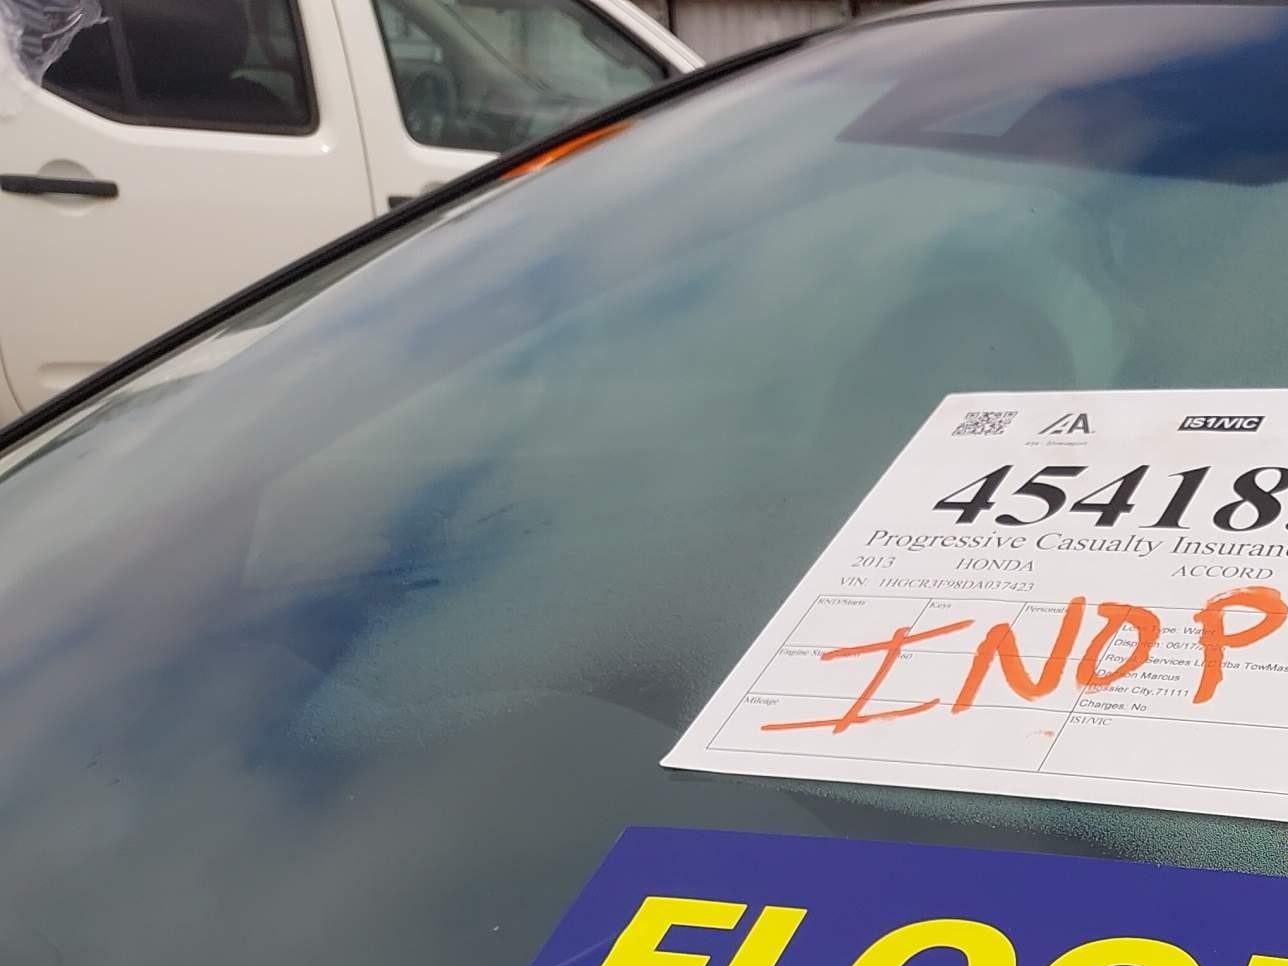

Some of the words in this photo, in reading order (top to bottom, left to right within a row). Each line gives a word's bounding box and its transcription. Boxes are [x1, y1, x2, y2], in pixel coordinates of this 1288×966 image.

[866, 529, 1028, 553] Progressive
[1036, 531, 1163, 558] Casualty
[851, 555, 896, 569] 2013
[955, 557, 1035, 573] HONDA
[1171, 564, 1274, 580] ACCORD
[1146, 656, 1191, 667] Services
[1139, 671, 1181, 681] Marcus
[1131, 703, 1147, 712] No
